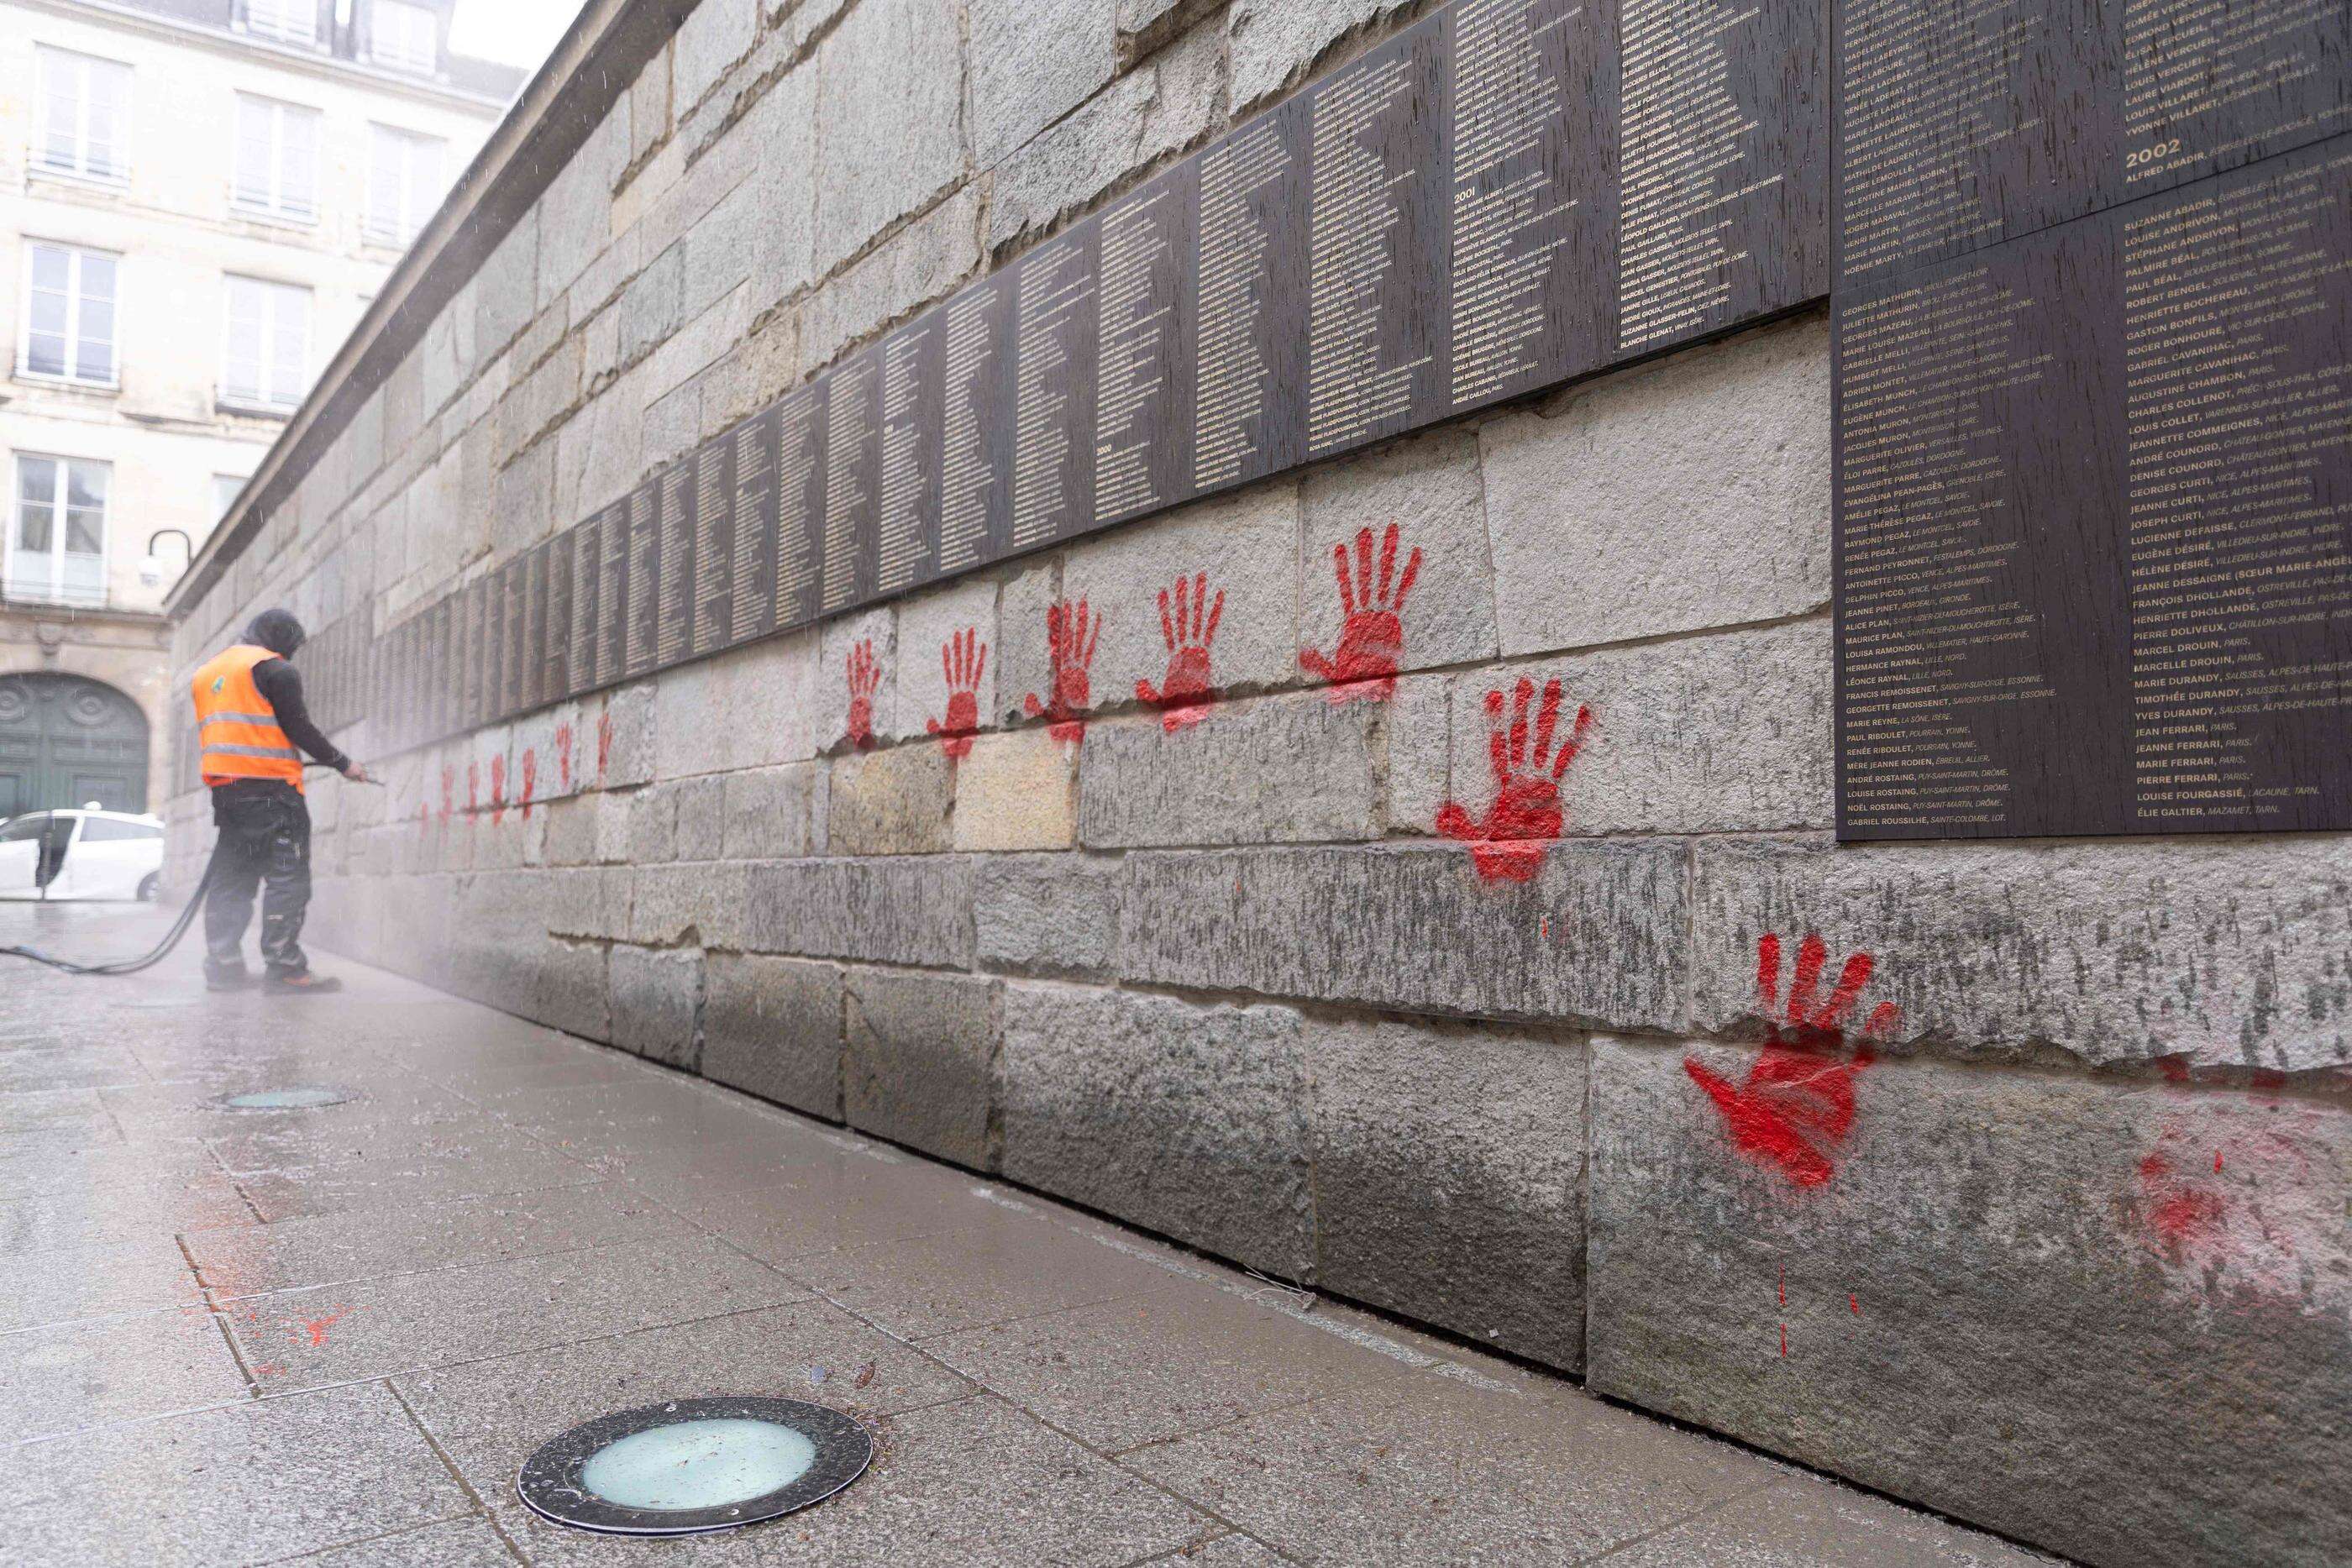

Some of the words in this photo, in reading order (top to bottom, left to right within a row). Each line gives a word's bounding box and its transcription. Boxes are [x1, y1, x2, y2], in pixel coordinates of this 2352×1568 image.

[1844, 98, 1867, 116] RENÉE
[1870, 85, 1905, 106] LADEBAT,
[2125, 88, 2157, 107] LAURE
[2160, 71, 2208, 95] VIARDOT,
[2126, 115, 2167, 138] YVONNE
[2170, 97, 2221, 123] VILLARET,
[1845, 134, 1882, 156] PIERRETTE
[1884, 119, 1922, 140] LAURENS,
[1844, 152, 1872, 170] ALBERT
[1873, 138, 1911, 159] LAURENT,
[2125, 137, 2181, 169] 2002
[2125, 164, 2163, 184] ALFRED
[2166, 150, 2207, 170] ABADIR,
[1454, 186, 1475, 205] 2001
[1844, 221, 1868, 236] ROGER
[1871, 207, 1909, 227] MARAVAL,
[2124, 210, 2171, 232] SUZANNE
[2174, 197, 2216, 217] ABADIR,
[1620, 226, 1646, 243] LÉOPOLD
[1648, 214, 1679, 232] GAILLARD,
[1844, 235, 1866, 249] HENRI
[1868, 224, 1900, 241] MARTIN,
[1620, 243, 1636, 254] PAUL
[1637, 231, 1668, 249] GAILLARD,
[1620, 250, 1647, 266] CHARLES
[1648, 241, 1673, 256] GASSER,
[1620, 267, 1635, 278] JEAN
[1635, 258, 1661, 272] GASSER,
[1841, 300, 1877, 317] GEORGES
[1878, 286, 1923, 307] MATHURIN,
[2126, 292, 2164, 310] ROBERT
[2167, 281, 2210, 299] BENGEL,
[2126, 323, 2167, 341] GASTON
[2170, 312, 2218, 331] BONFILS,
[1842, 353, 1882, 371] GABRIELLE
[1884, 346, 1910, 360] MELLI,
[2127, 355, 2169, 373] GABRIEL
[2171, 340, 2234, 363] CAVANIHAC,
[2128, 401, 2174, 419] CHARLES
[2176, 389, 2234, 409] COLLENOT,
[2129, 421, 2158, 435] LOUIS
[2160, 412, 2202, 428] COLLET,
[2129, 432, 2184, 451] JEANNETTE
[2187, 417, 2263, 440] COMMEIGNES,
[1843, 448, 1892, 467] MARGUERITE
[1893, 441, 1927, 456] OLIVIER,
[1843, 477, 1892, 494] MARGUERITE
[1893, 471, 1922, 484] PARRE,
[2129, 481, 2176, 498] GEORGES
[2179, 475, 2213, 490] CURTI,
[2215, 471, 2238, 484] NICE,
[2130, 499, 2168, 514] JEANNE
[2171, 494, 2205, 507] CURTI,
[1844, 535, 1882, 549] RAYMOND
[1884, 530, 1911, 542] PEGAZ,
[2130, 530, 2181, 546] LUCIENNE
[2184, 522, 2237, 538] DEFAISSE,
[2131, 546, 2171, 561] EUGÈNE
[2174, 539, 2214, 555] DÉSIRÉ,
[2131, 562, 2171, 577] HÉLÈNE
[2173, 556, 2213, 572] DÉSIRÉ,
[2132, 579, 2170, 593] JEANNE
[2172, 572, 2231, 588] DESSAIGNE
[2234, 566, 2272, 579] (SŒUR
[2134, 644, 2174, 657] MARCEL
[2177, 640, 2222, 653] DROUIN,
[2223, 637, 2251, 648] PARIS.
[1845, 674, 1876, 686] LÉONCE
[1877, 672, 1910, 684] RAYNAL,
[1911, 670, 1930, 680] LILLE,
[1931, 668, 1953, 678] NORD.
[1845, 703, 1890, 715] GEORGETTE
[1891, 697, 1951, 711] REMOISSENET,
[2134, 711, 2160, 721] YVES
[2163, 706, 2217, 719] DURANDY,
[2135, 726, 2160, 737] JEAN
[2162, 724, 2208, 735] FERRARI,
[2210, 721, 2237, 732] PARIS.
[1846, 759, 1867, 770] MÈRE
[1869, 759, 1899, 769] JEANNE
[1901, 758, 1935, 767] RODIEN,
[2136, 759, 2168, 768] MARIE
[2171, 757, 2217, 768] FERRARI,
[2218, 755, 2245, 765] PARIS.
[1846, 773, 1873, 784] ANDRÉ
[1874, 773, 1917, 783] ROSTAING,
[1847, 789, 1875, 798] LOUISE
[1876, 787, 1919, 797] ROSTAING,
[2137, 791, 2173, 800] LOUISE
[2176, 787, 2246, 800] FOURGASSIÉ,
[1847, 817, 1880, 826] GABRIEL
[1881, 815, 1929, 826] ROUSSILHE,
[1991, 814, 2006, 822] LOT.
[2137, 806, 2158, 817] ÉLIE
[2160, 807, 2206, 816] GALTIER,
[2208, 805, 2253, 815] MAZAMET,
[2254, 805, 2280, 814] TARN.
